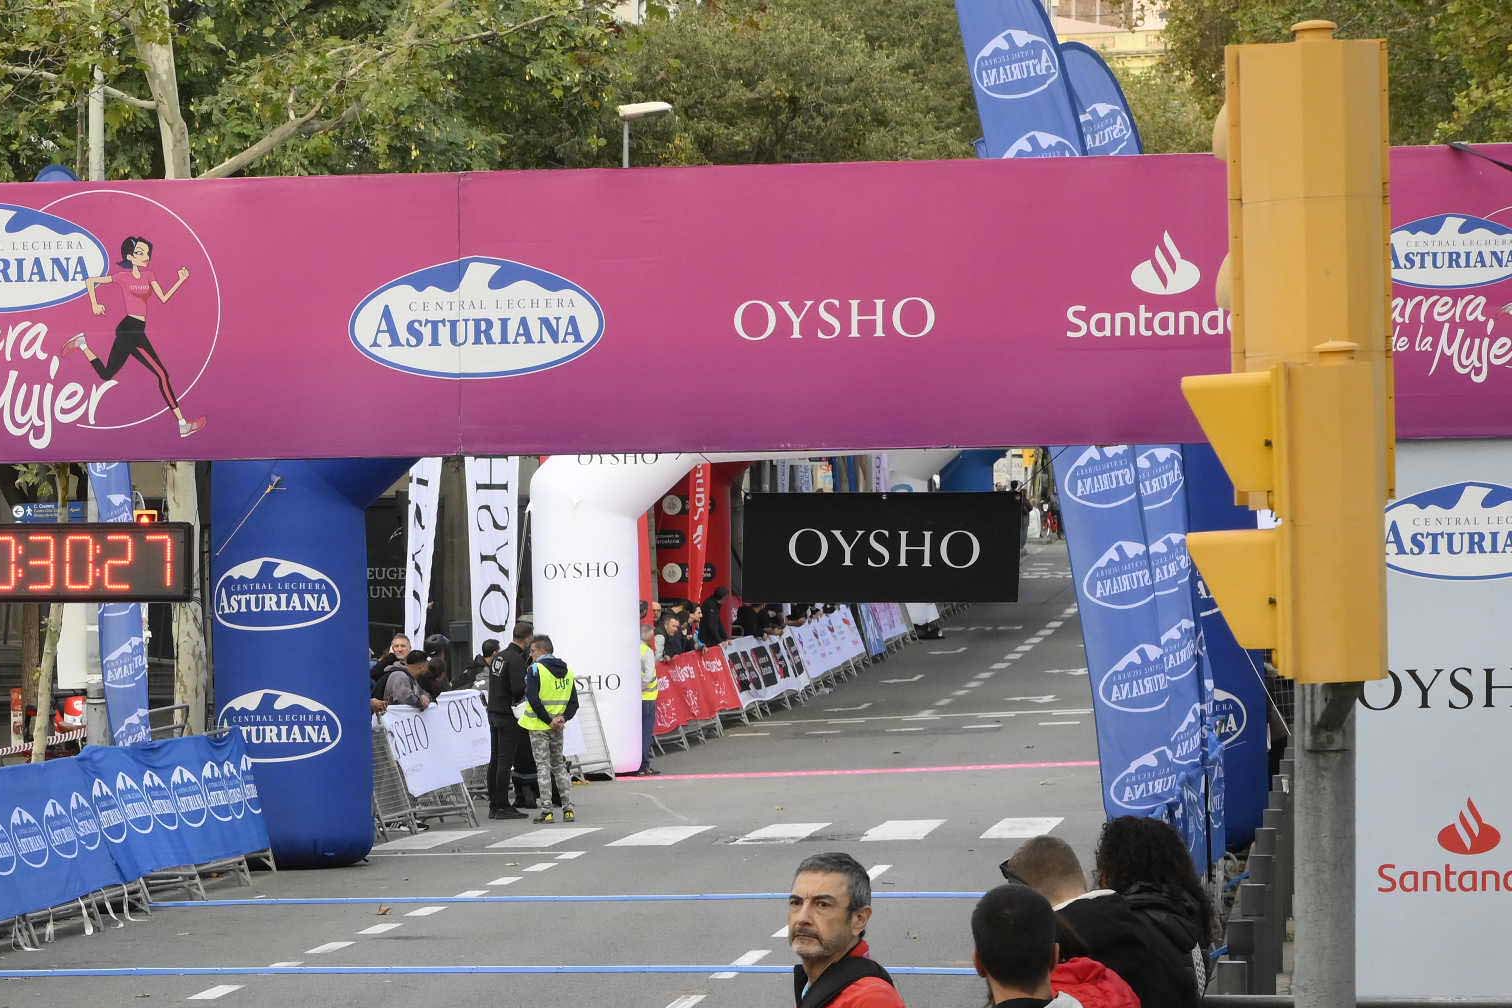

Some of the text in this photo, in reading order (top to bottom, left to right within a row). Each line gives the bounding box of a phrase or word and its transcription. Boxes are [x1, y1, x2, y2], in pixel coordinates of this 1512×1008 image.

[12, 240, 84, 251] LECHERA
[1406, 239, 1456, 248] CENTRAL
[409, 297, 577, 311] CENTRAL LECHERA
[1391, 294, 1486, 323] arrera
[369, 303, 585, 348] ASTURIANA
[733, 296, 936, 341] OYSHO
[1066, 303, 1233, 338] Santand
[1412, 325, 1433, 353] la
[1412, 516, 1480, 526] CENTRAL
[788, 527, 981, 569] OYSHO
[543, 560, 620, 582] OYSHO
[278, 582, 327, 591] LECHERA
[218, 587, 332, 615] ASTURIANA
[278, 713, 328, 722] LECHERA
